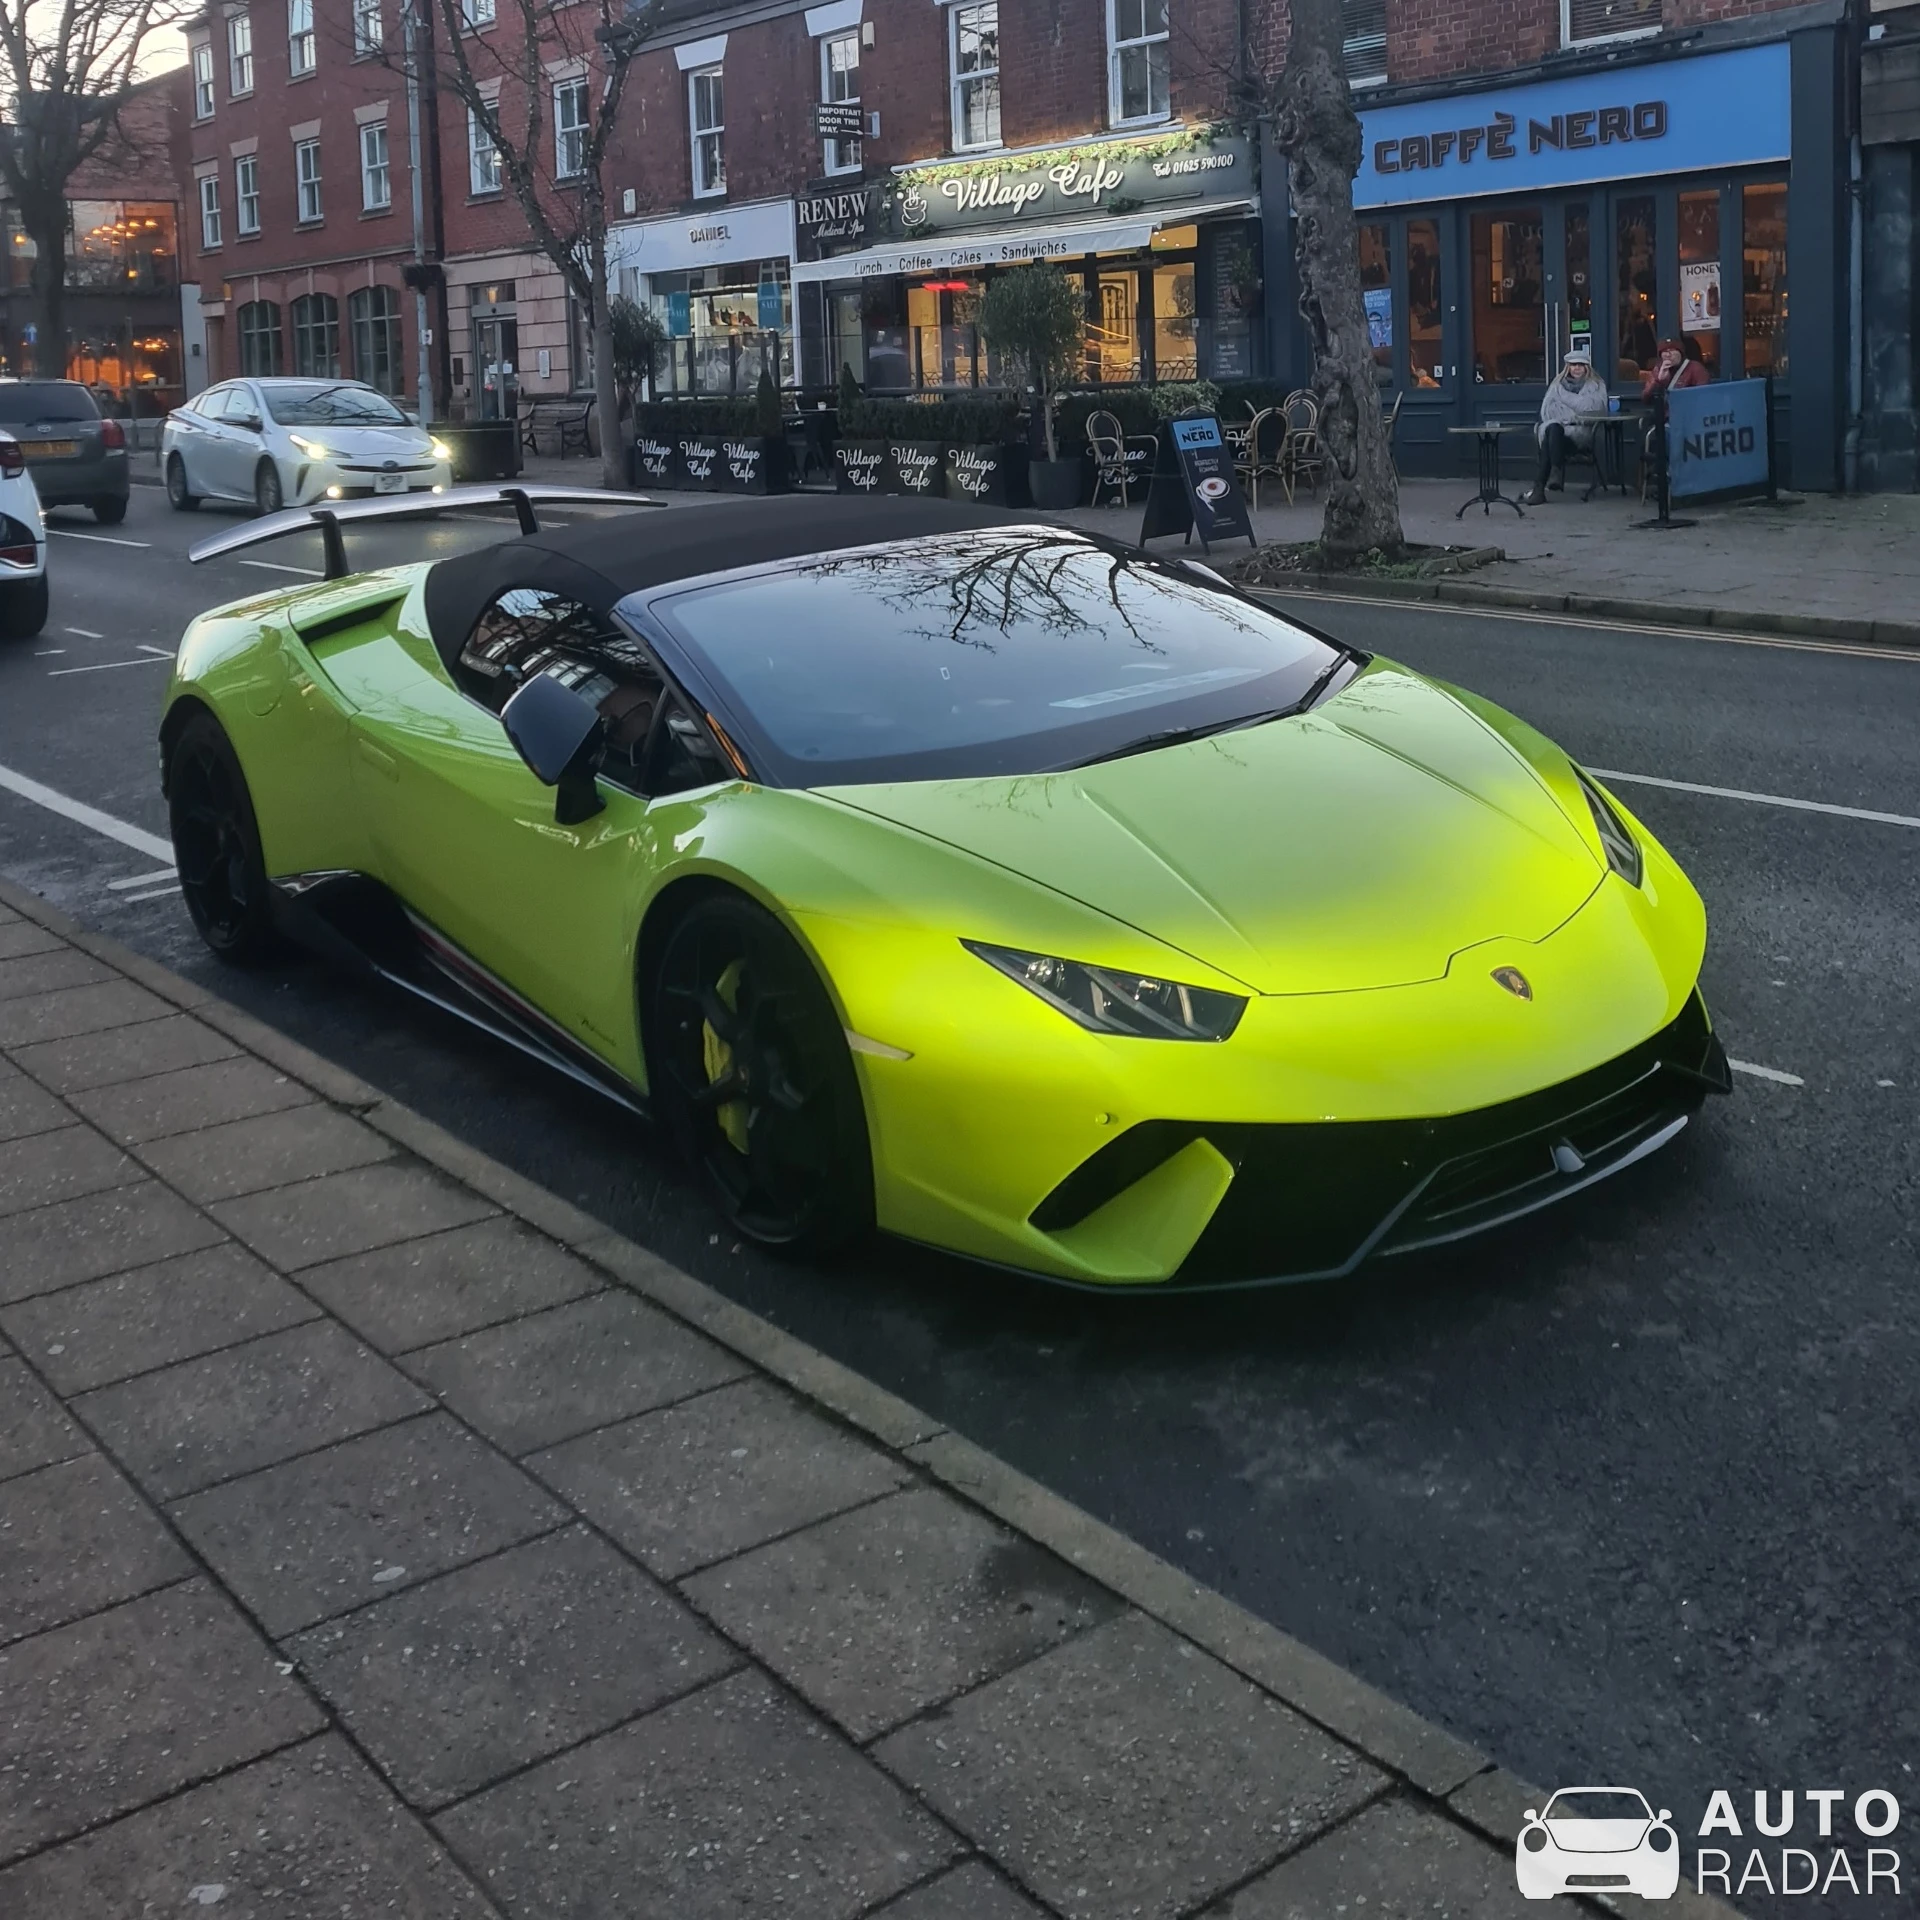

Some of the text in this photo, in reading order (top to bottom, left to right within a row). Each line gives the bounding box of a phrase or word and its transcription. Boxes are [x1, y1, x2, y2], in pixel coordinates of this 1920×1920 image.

[819, 107, 861, 116] IMPORTANT
[819, 117, 860, 126] DOOR THIS
[1374, 100, 1667, 174] CAFFÈ NERO
[1152, 154, 1234, 177] Tel 01625 590100
[942, 158, 1124, 214] Village Cafe
[798, 191, 869, 225] RENEW
[690, 225, 731, 244] DANIEL
[812, 219, 865, 239] Medical Spa
[854, 241, 1067, 275] Lunch Coffee Cakes Sandwiches
[762, 300, 778, 309] SALE
[1182, 431, 1214, 443] NERO
[1683, 426, 1753, 463] NERO
[637, 439, 672, 460] Village
[680, 441, 716, 462] Village
[723, 442, 760, 464] Village
[836, 449, 882, 469] Village
[891, 447, 938, 470] Village
[643, 457, 667, 478] Cafe
[687, 460, 711, 480] Cafe
[730, 462, 755, 483] Cafe
[949, 449, 997, 476] Village
[848, 469, 878, 491] Cafe
[900, 469, 930, 492] Cafe
[958, 472, 990, 497] Cafe
